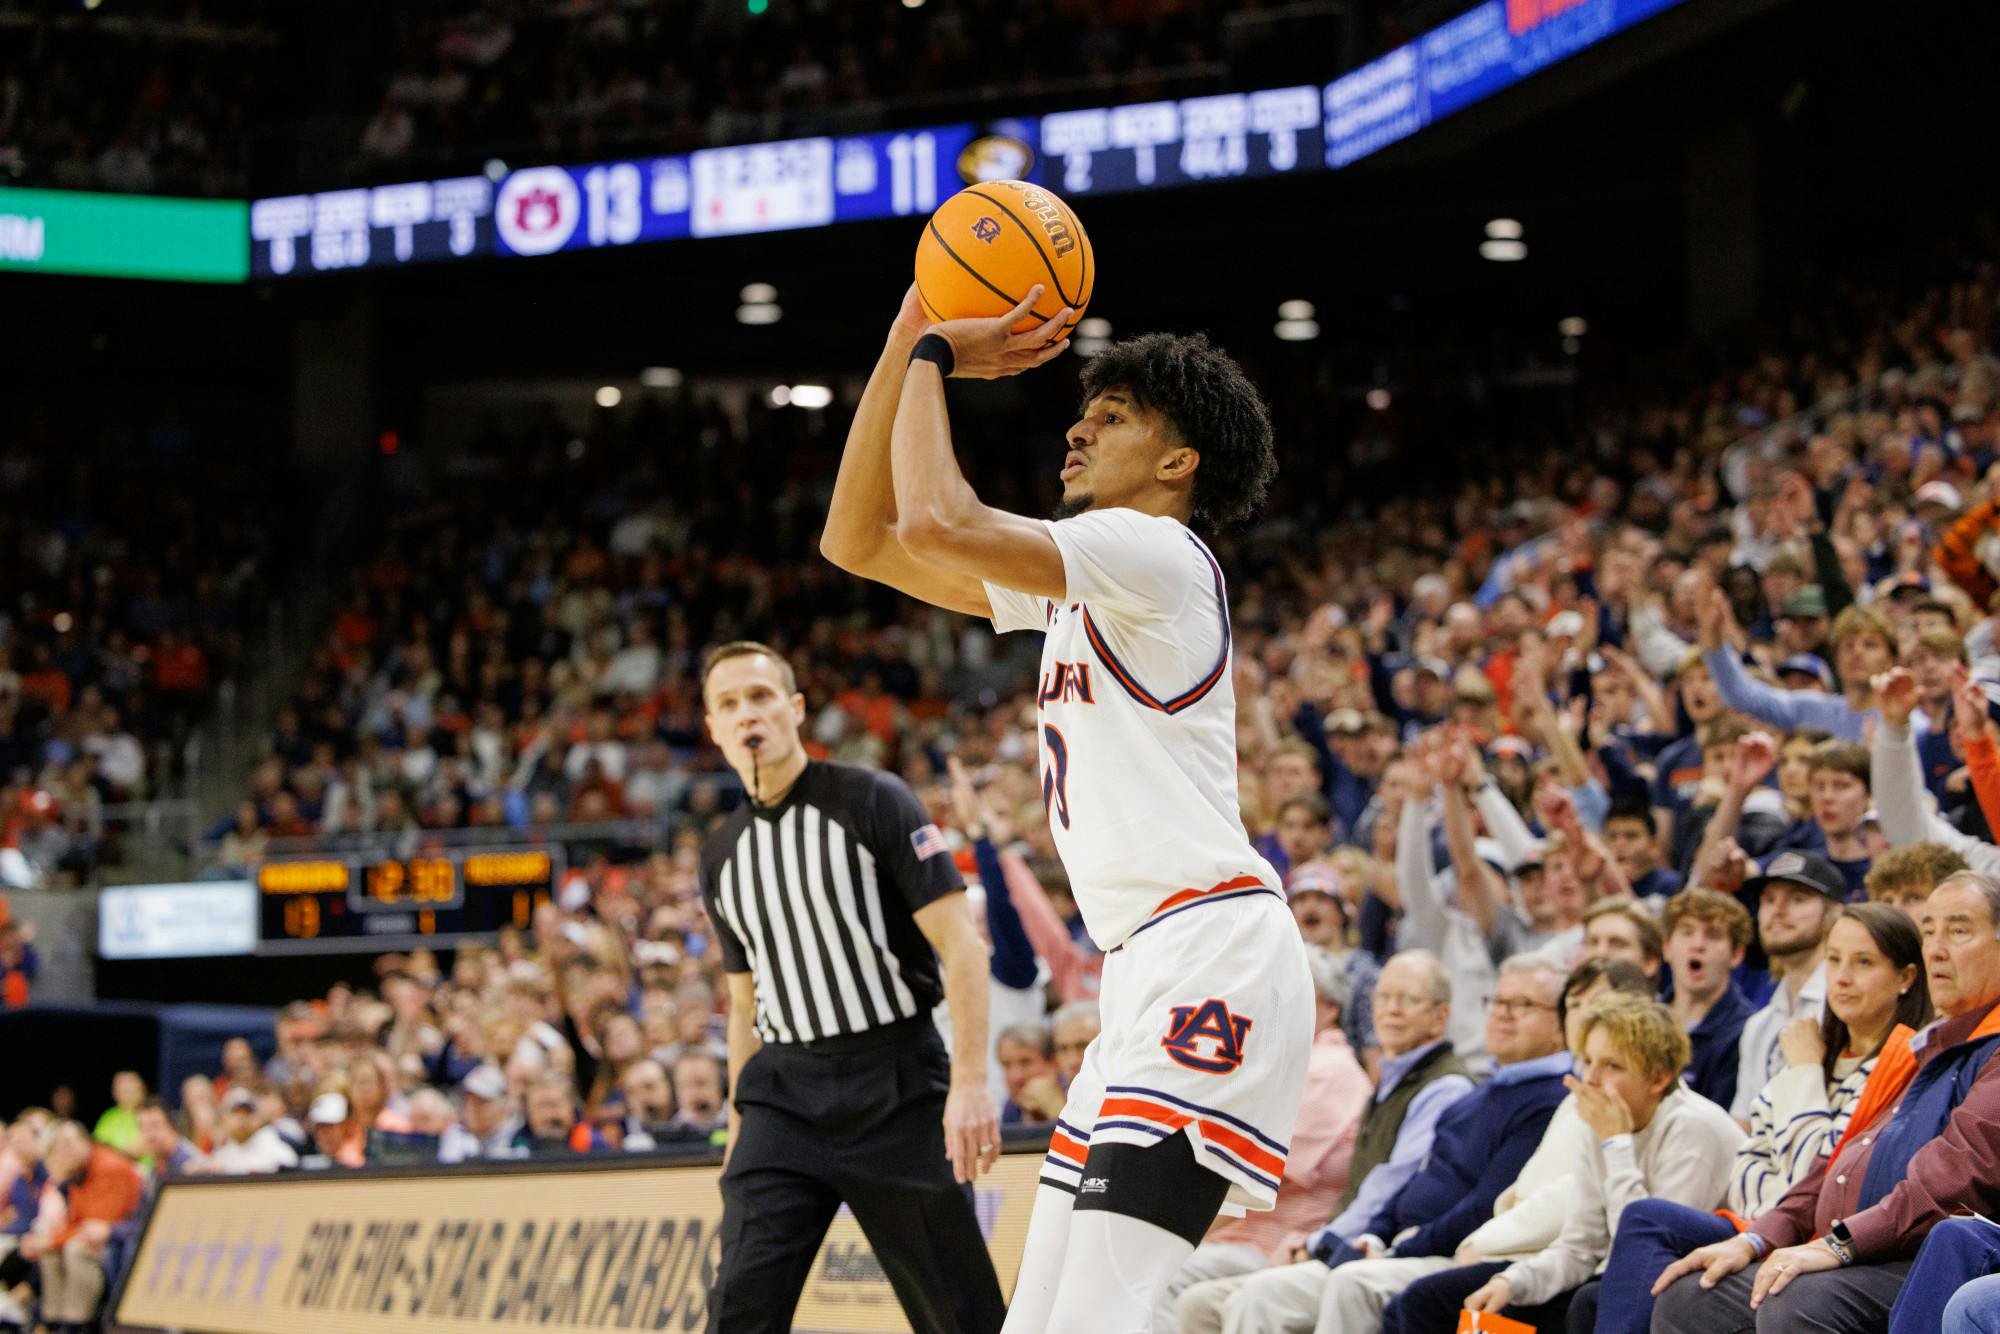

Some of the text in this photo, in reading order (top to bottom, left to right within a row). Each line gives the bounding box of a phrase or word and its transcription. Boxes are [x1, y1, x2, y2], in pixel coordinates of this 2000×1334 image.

[584, 163, 642, 246] 13
[887, 132, 936, 215] 11
[1064, 151, 1092, 192] 2
[1008, 183, 1074, 259] Wils
